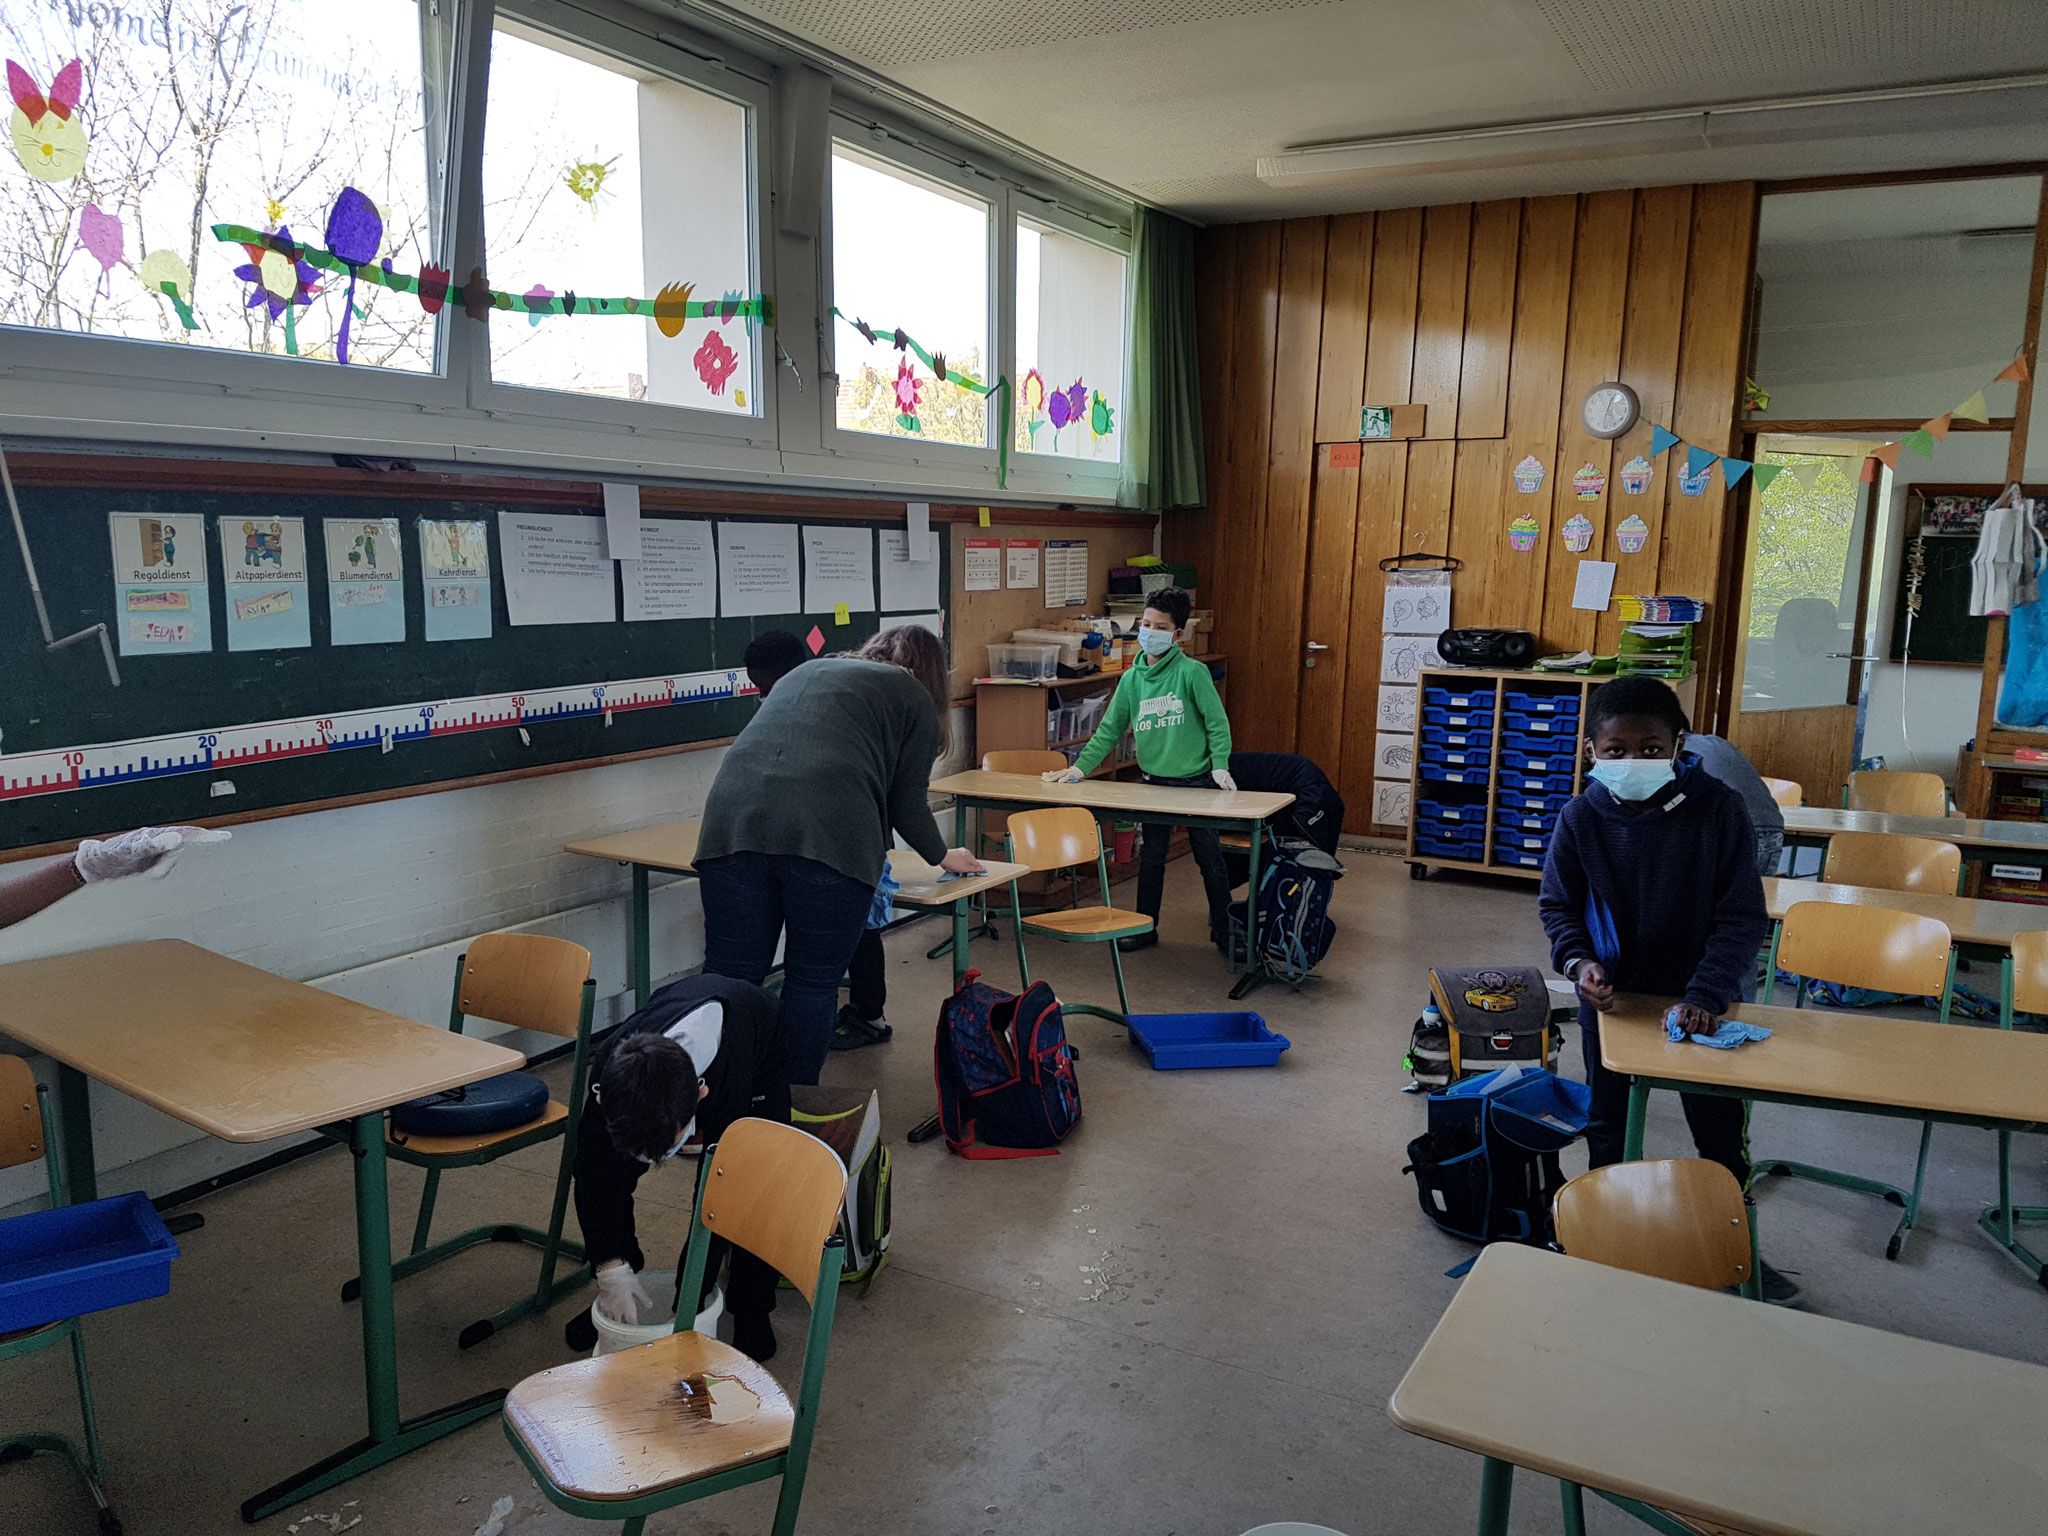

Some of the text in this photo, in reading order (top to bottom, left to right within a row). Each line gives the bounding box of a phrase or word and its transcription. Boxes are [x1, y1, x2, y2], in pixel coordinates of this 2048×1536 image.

[133, 569, 191, 582] Regaldienst
[235, 570, 302, 582] Altpapierdienst
[340, 570, 393, 580] Blumendienst
[439, 568, 477, 577] Kehrdienst
[727, 672, 737, 682] 80
[664, 680, 675, 689] 70
[592, 688, 605, 698] 60
[511, 696, 525, 707] 50
[419, 707, 434, 719] 40
[316, 719, 333, 732] 30
[1136, 720, 1152, 731] LOS
[198, 735, 217, 748] 20
[62, 752, 84, 767] 10
